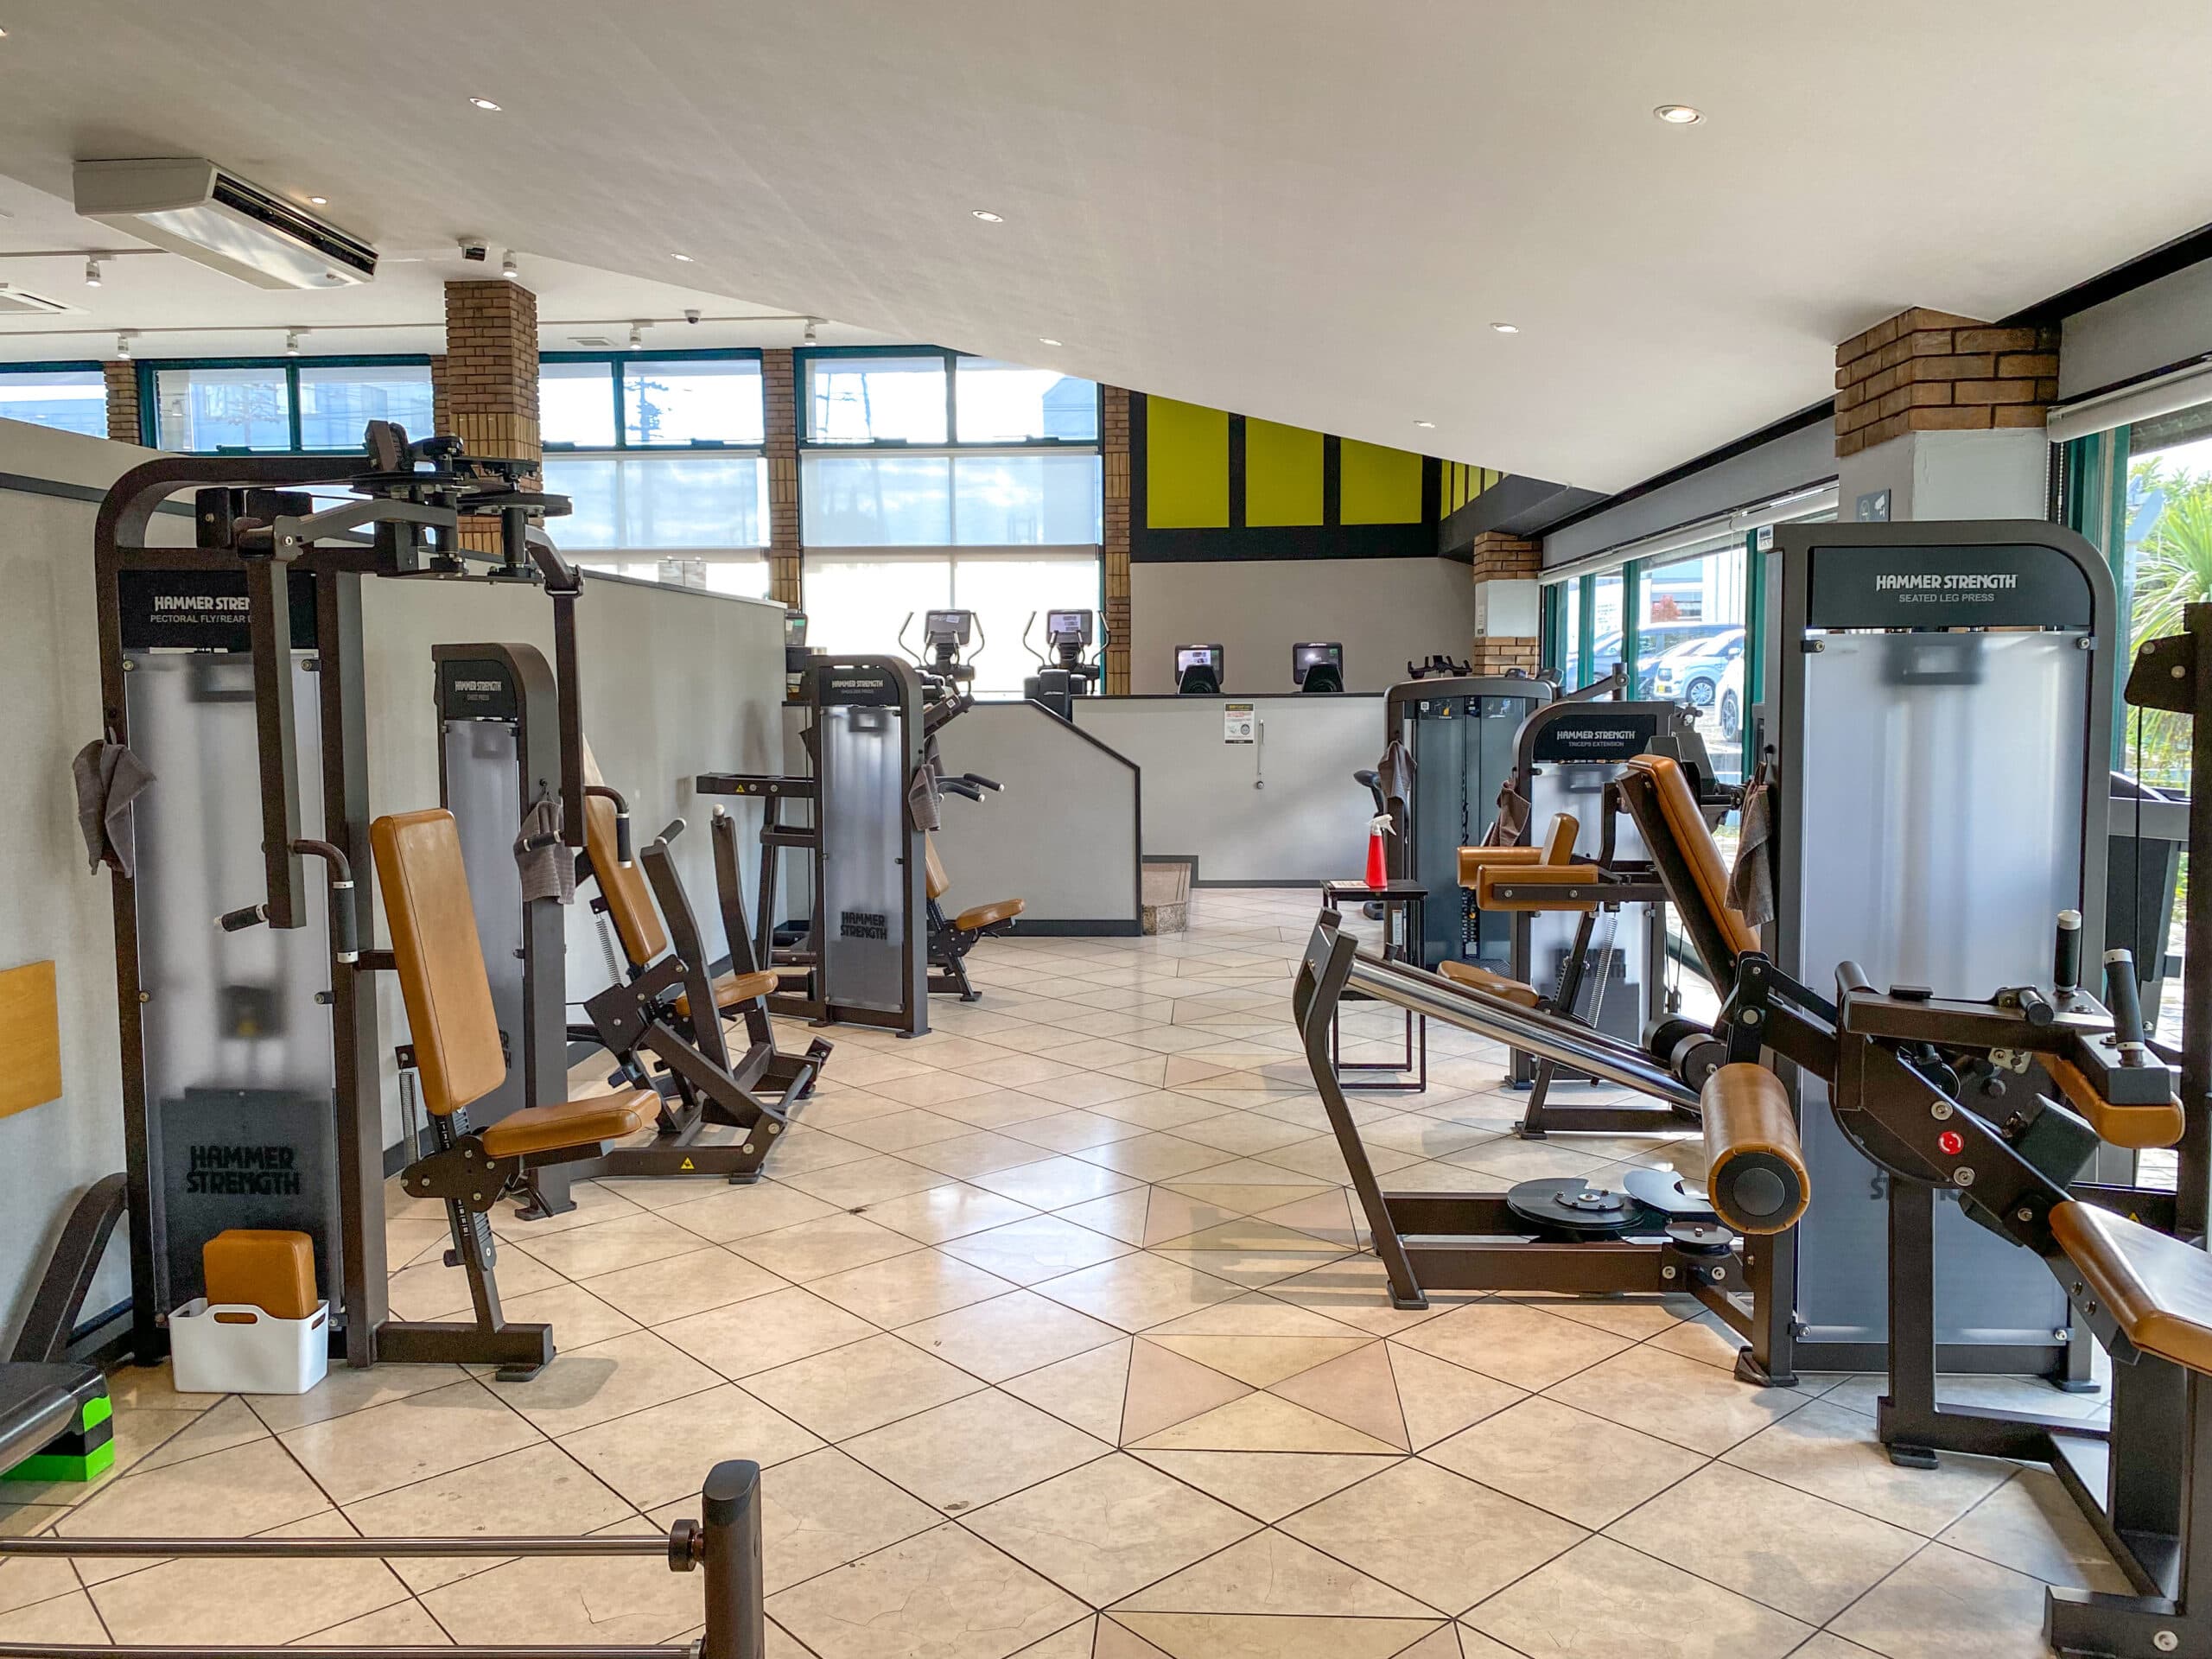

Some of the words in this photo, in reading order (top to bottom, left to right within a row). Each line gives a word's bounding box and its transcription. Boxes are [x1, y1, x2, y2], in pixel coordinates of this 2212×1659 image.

[1876, 575, 1942, 592] HAMMER
[1944, 575, 2017, 588] STRENGTH
[155, 596, 213, 612] HAMMER
[1899, 594, 1937, 602] SEATED
[1940, 594, 1960, 602] LEG
[1961, 594, 1994, 602] PRESS
[150, 614, 198, 623] PECTORAL
[200, 614, 245, 623] FLY/REAR
[454, 681, 477, 692] HAMMER
[477, 681, 502, 691] STRENGTH
[832, 679, 856, 689] HAMMER
[856, 679, 883, 688] STRENGTH
[1557, 731, 1593, 740] HAMMER
[1594, 731, 1636, 740] STRENGTH
[842, 912, 885, 926] HAMMER
[841, 925, 887, 940] STRENGTH
[190, 1145, 294, 1171] HAMMER
[187, 1170, 300, 1195] STRENGTH
